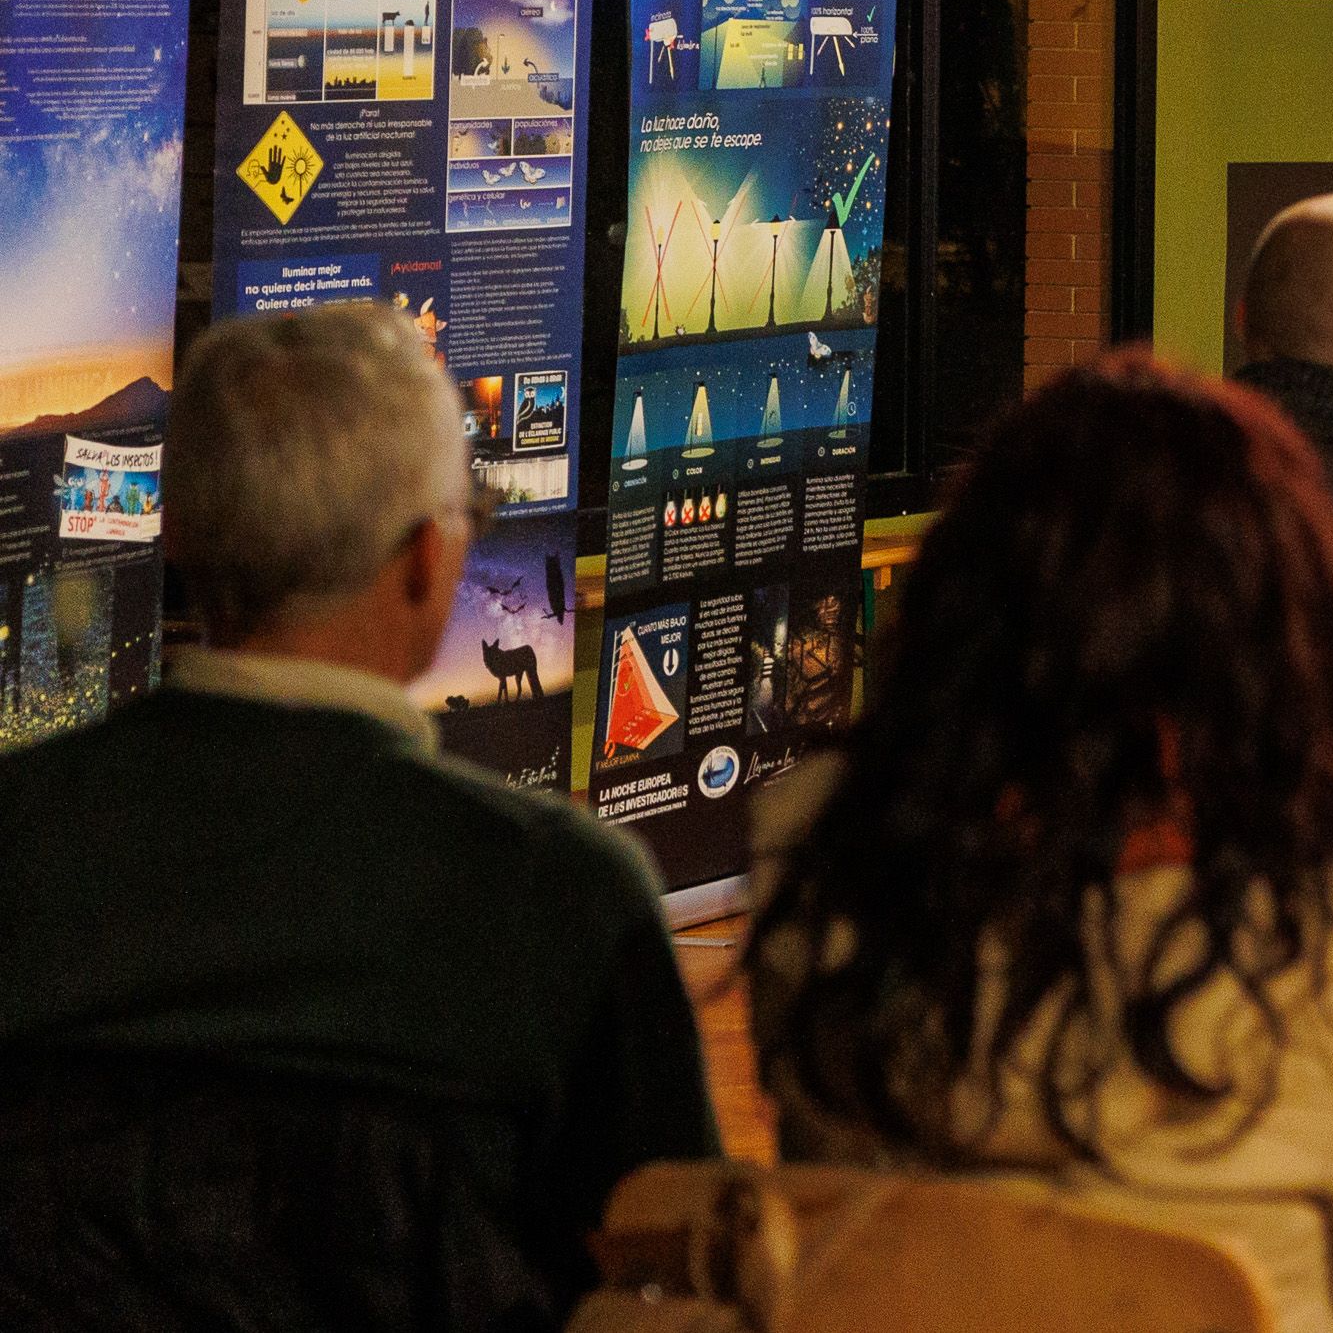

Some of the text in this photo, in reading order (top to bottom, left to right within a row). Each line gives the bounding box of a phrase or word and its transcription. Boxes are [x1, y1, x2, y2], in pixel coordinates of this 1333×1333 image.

[822, 7, 854, 16] horizontal
[640, 112, 720, 133] La luz hace daño,
[639, 132, 763, 154] no dejes que se te escape.
[282, 264, 342, 278] Iluminar mejor
[245, 285, 259, 295] no
[260, 282, 292, 296] quiere
[293, 280, 316, 292] decir
[316, 277, 350, 289] iluminar
[255, 298, 290, 311] Quiere
[67, 516, 94, 533] STOP
[670, 616, 686, 628] BAJO
[660, 632, 682, 645] MEJOR
[599, 772, 672, 803] LA NOCHE EUROPEA
[598, 804, 609, 819] DE
